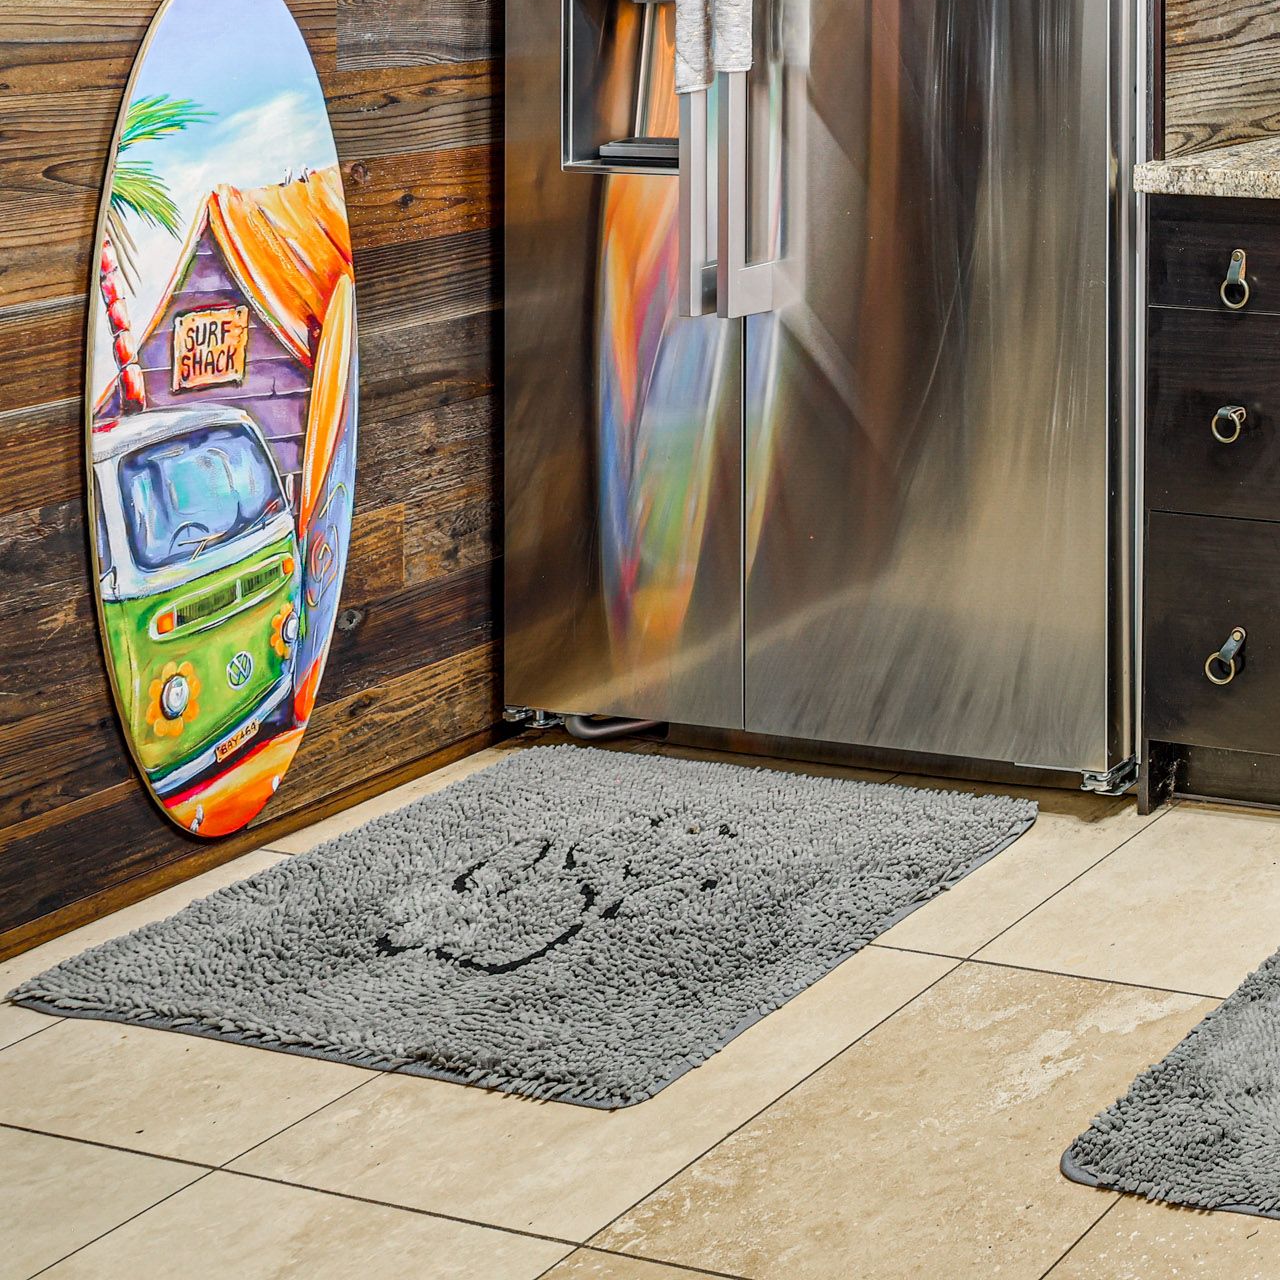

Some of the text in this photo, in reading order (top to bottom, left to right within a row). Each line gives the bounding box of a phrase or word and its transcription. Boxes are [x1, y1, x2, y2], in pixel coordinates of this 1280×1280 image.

[184, 320, 233, 352] SURF
[181, 345, 237, 382] SHACK
[220, 736, 240, 754] BAY
